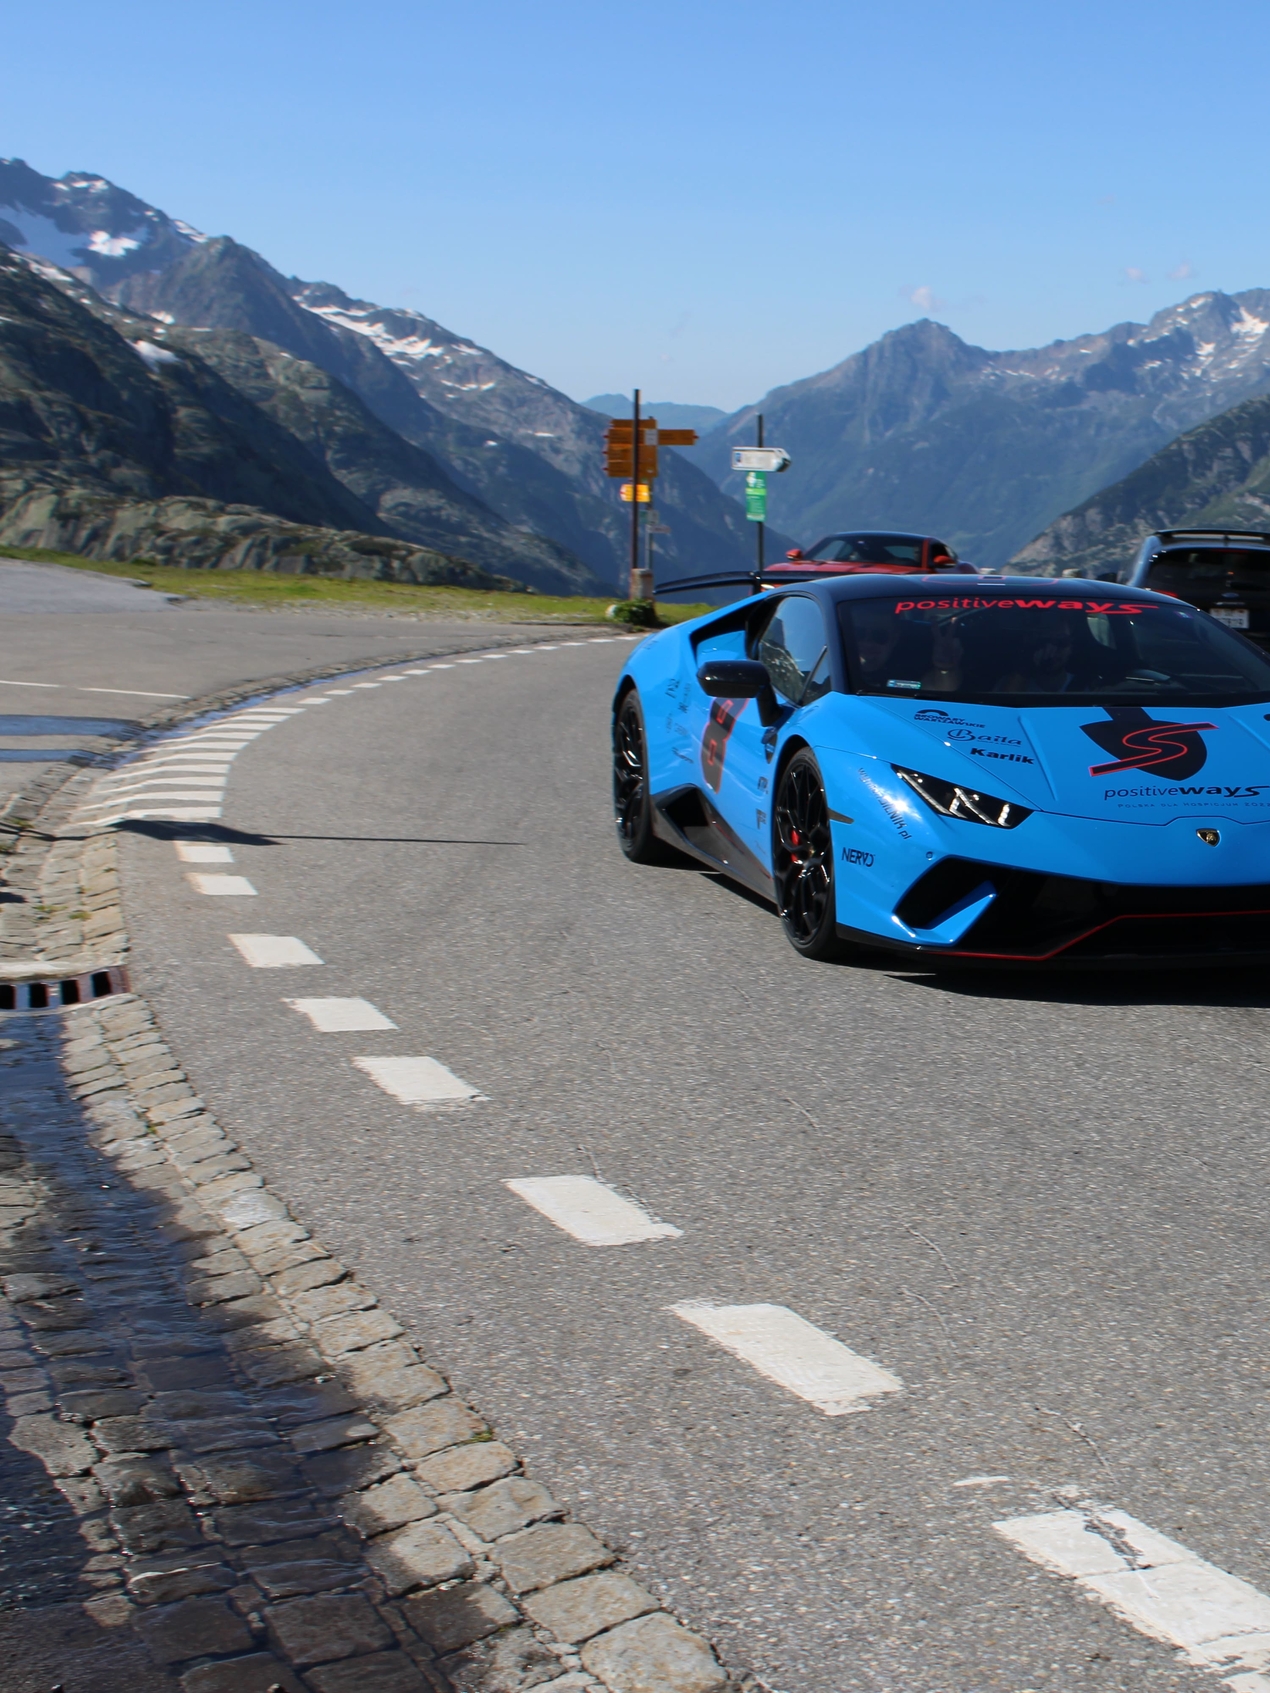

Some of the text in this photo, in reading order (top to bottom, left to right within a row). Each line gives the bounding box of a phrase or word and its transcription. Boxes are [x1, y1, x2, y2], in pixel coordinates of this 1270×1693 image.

[895, 597, 1159, 614] positiveways
[970, 747, 1034, 764] Karlik
[1103, 785, 1270, 801] positiveways
